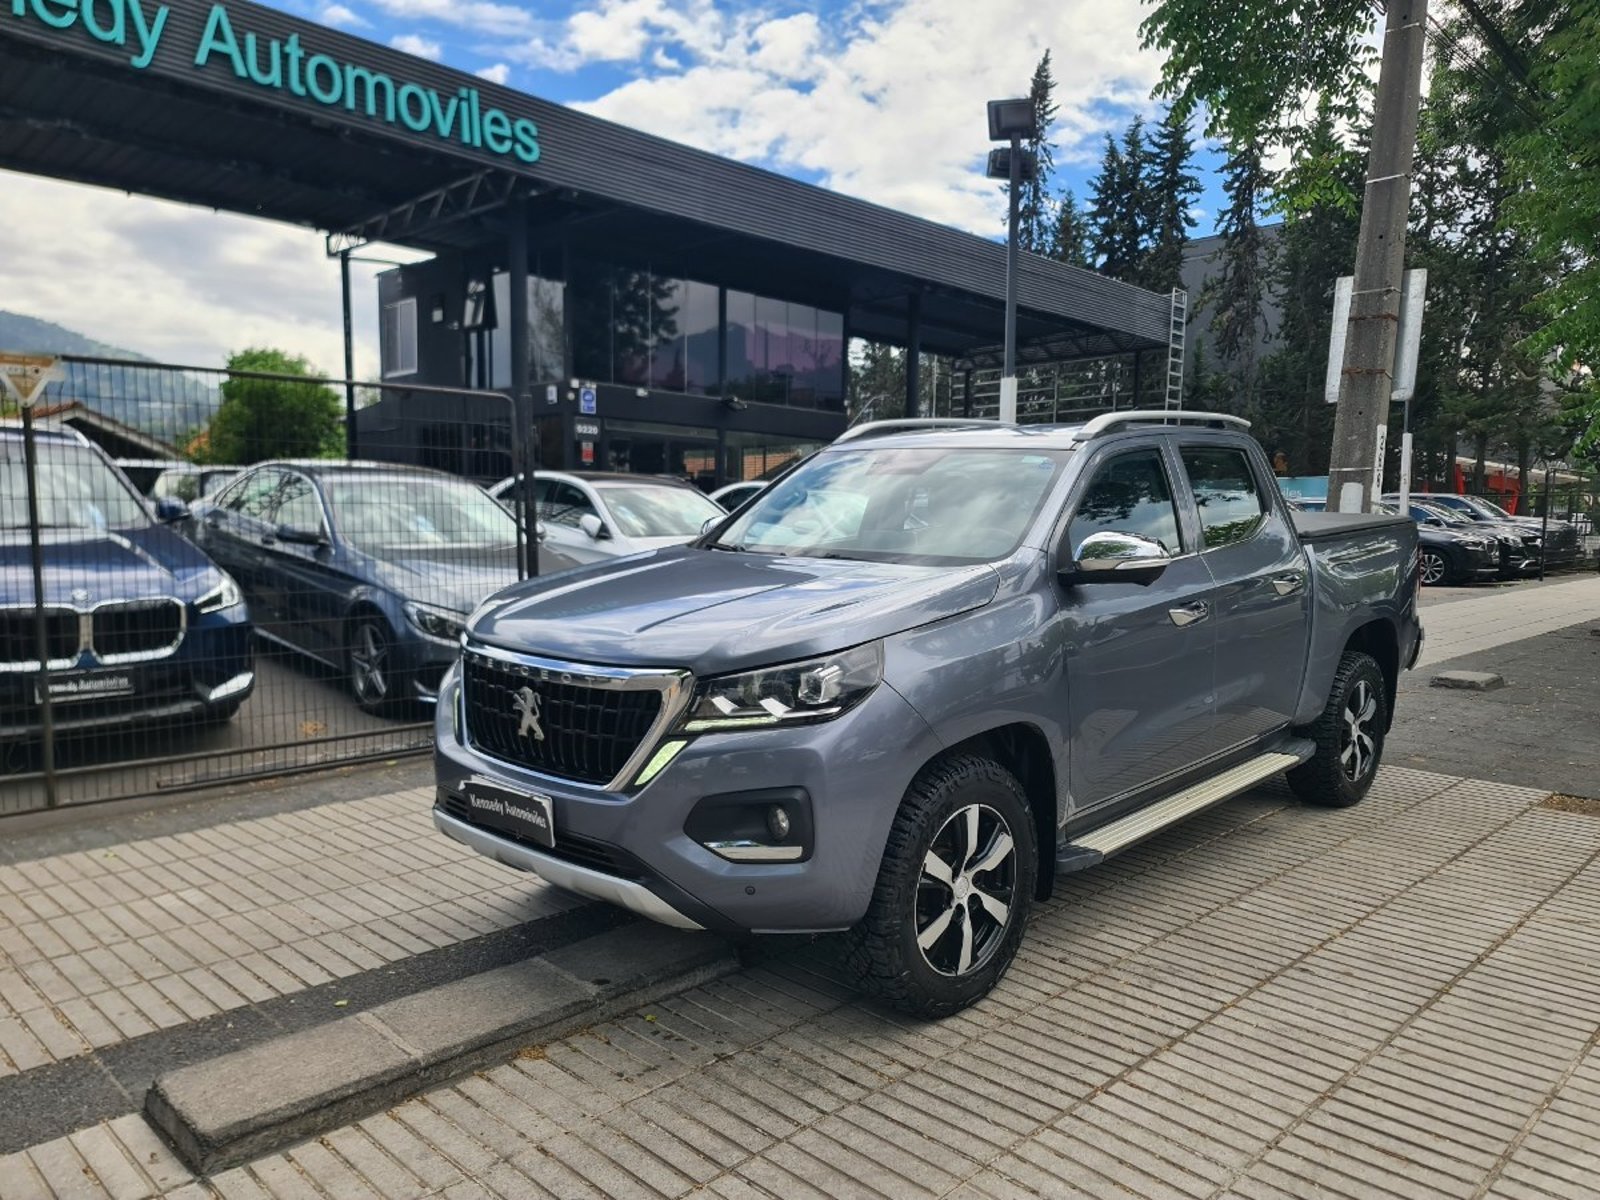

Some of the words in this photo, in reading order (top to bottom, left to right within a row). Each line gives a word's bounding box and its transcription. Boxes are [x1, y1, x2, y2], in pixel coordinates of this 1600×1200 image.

[12, 0, 169, 68] edy
[195, 3, 541, 163] Automoviles
[472, 654, 596, 687] PEUGEOT
[469, 793, 504, 816] Kennedy
